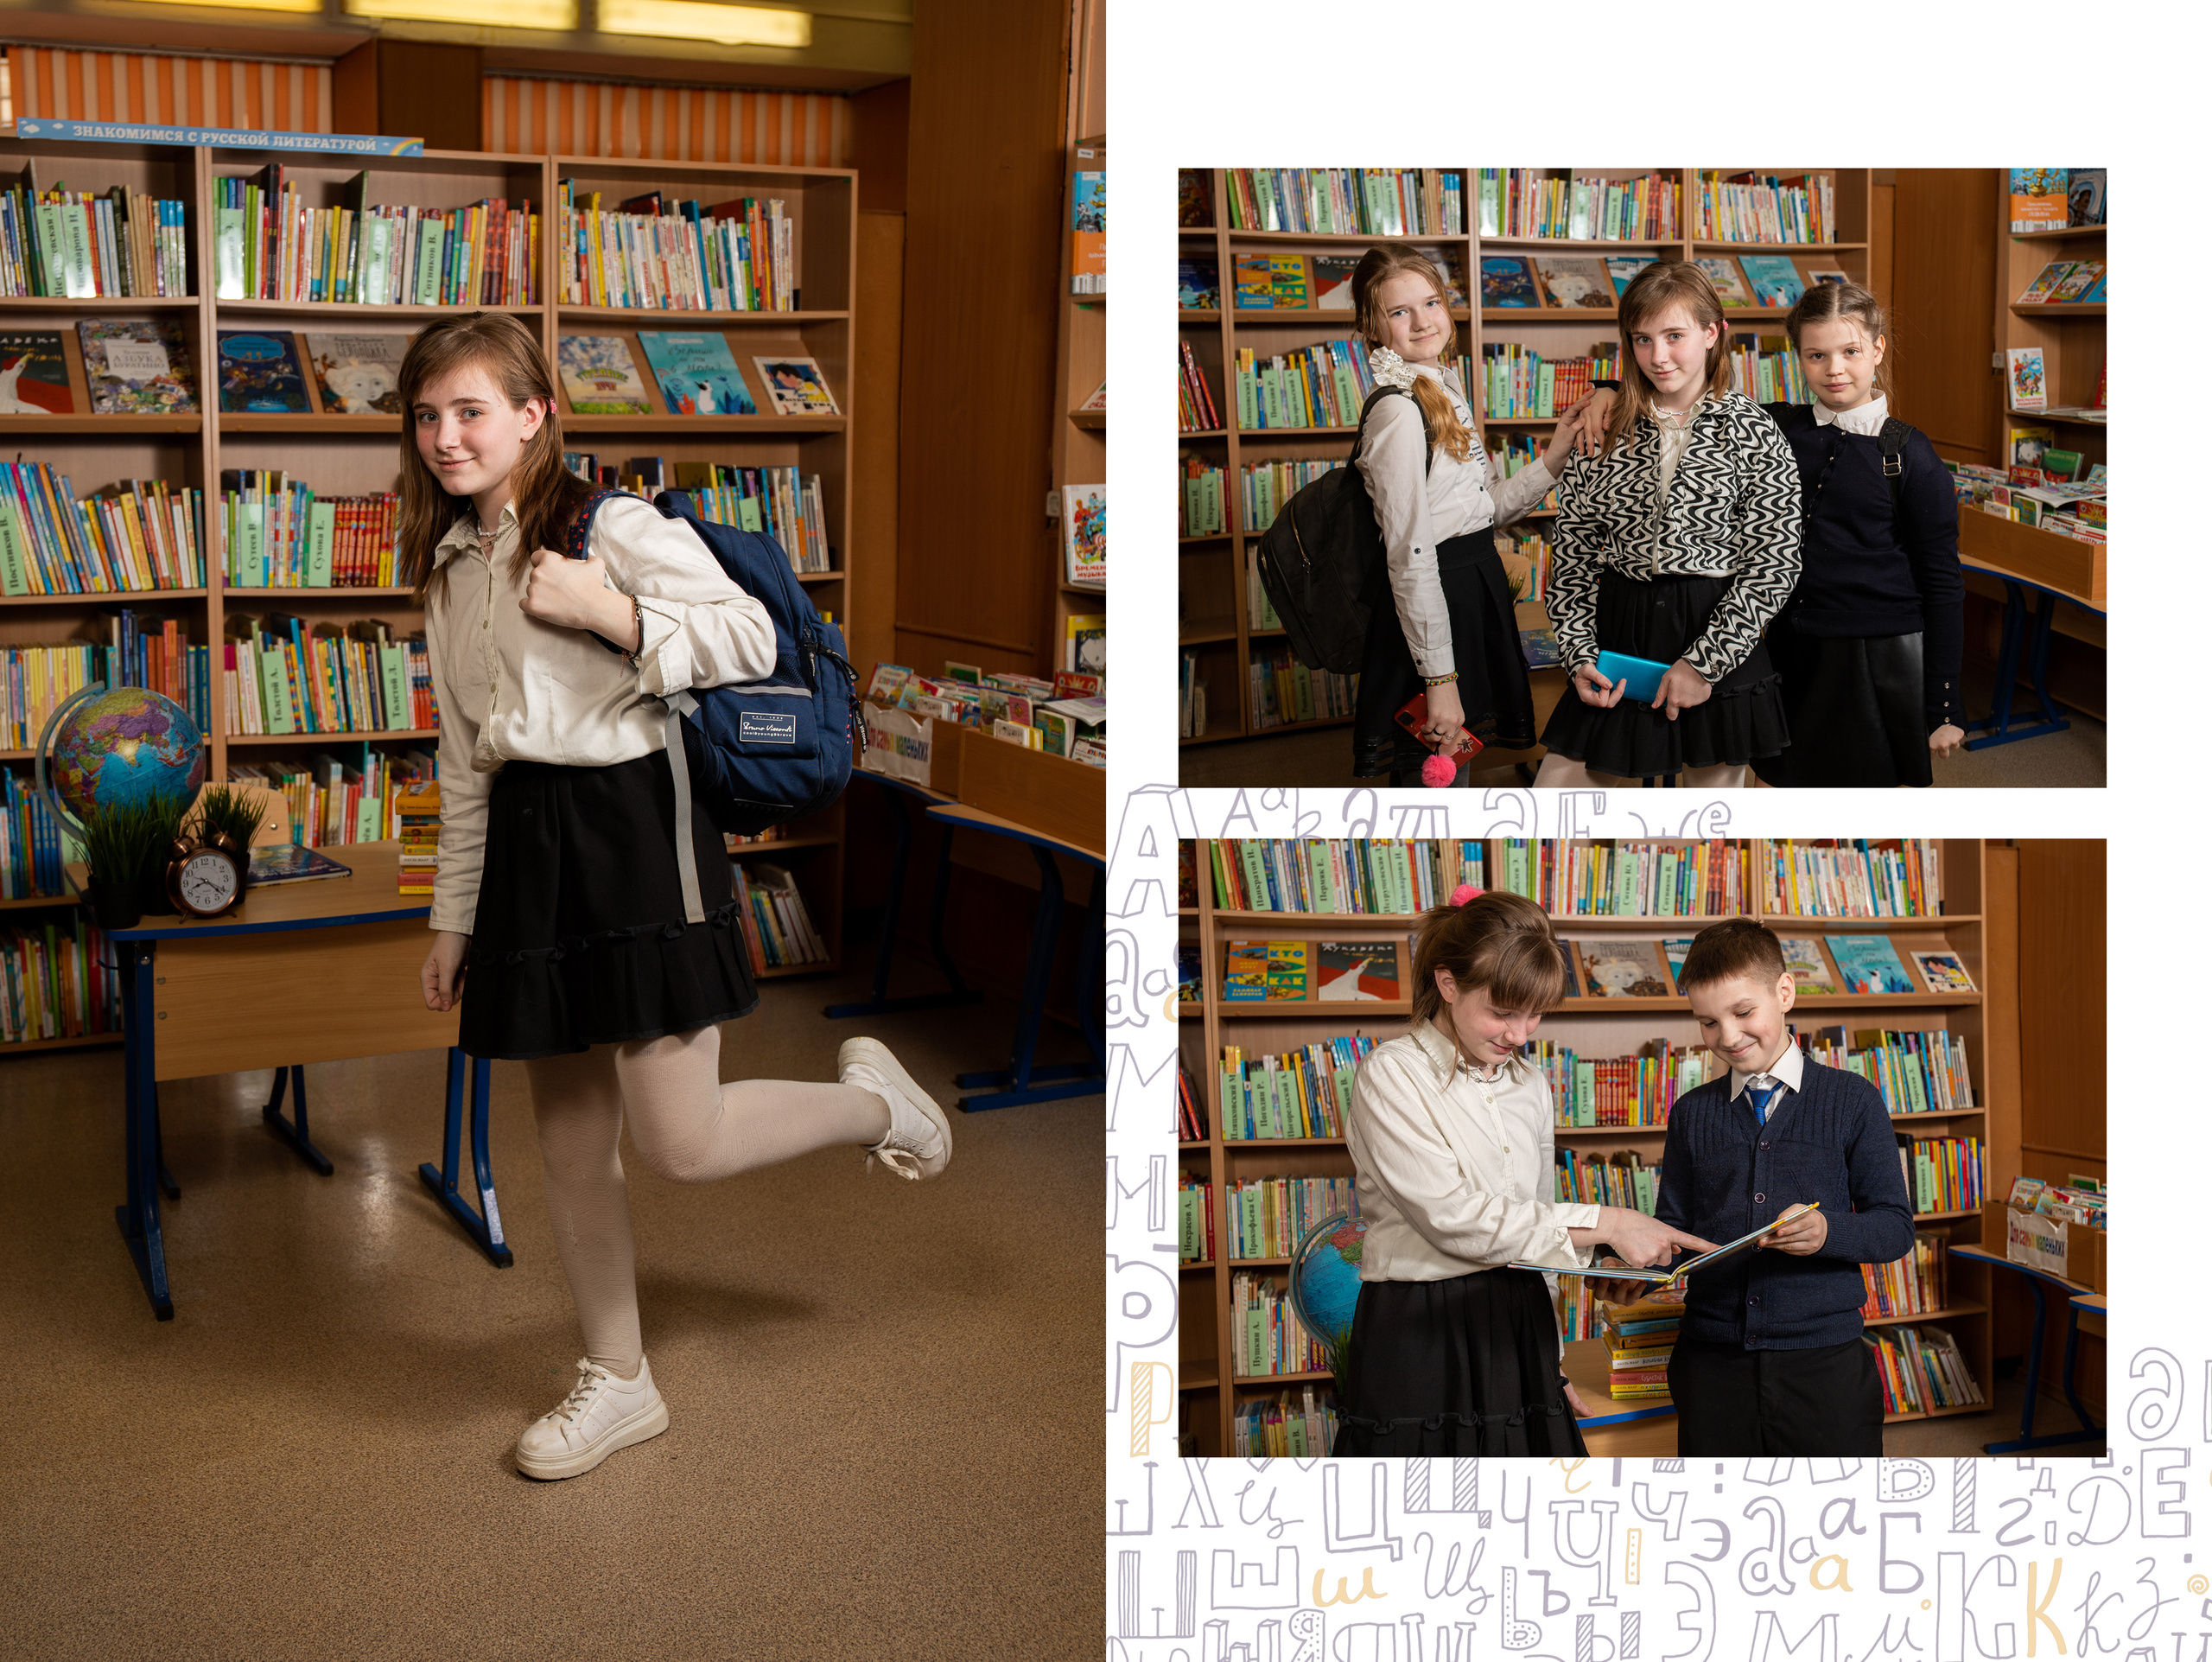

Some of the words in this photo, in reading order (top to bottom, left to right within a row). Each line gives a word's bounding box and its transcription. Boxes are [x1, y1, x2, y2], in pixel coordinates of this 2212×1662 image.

[73, 124, 184, 142] ЗНАКОМИМСЯ
[188, 131, 197, 142] С
[201, 131, 270, 147] РУССКОЙ
[273, 135, 377, 151] ЛИТЕРАТУРОЙ
[429, 234, 436, 244] В.
[424, 248, 435, 297] Сотников
[1261, 483, 1269, 527] Прокофьева
[316, 520, 325, 530] Е.
[3, 529, 19, 588] Постников
[249, 534, 257, 570] Сутеев
[315, 533, 325, 570] Сухова
[270, 669, 277, 678] А.
[389, 665, 397, 676] Л.
[272, 682, 282, 722] Толстой
[391, 678, 400, 717] Толстой
[743, 722, 766, 730] Bruno
[895, 735, 929, 762] маленьких
[1317, 858, 1324, 867] Е.
[1250, 861, 1264, 907] Панкратов
[1319, 869, 1327, 901] Пермяк
[1259, 1092, 1268, 1127] Погодин
[1283, 1084, 1294, 1137] Погорельский
[1247, 1194, 1254, 1202] С.
[1184, 1212, 1192, 1251] Некрасов
[1249, 1204, 1258, 1254] Прокофьева
[2036, 1233, 2065, 1258] маленьких
[1253, 1333, 1262, 1366] Пушкин
[1293, 1429, 1300, 1437] В.
